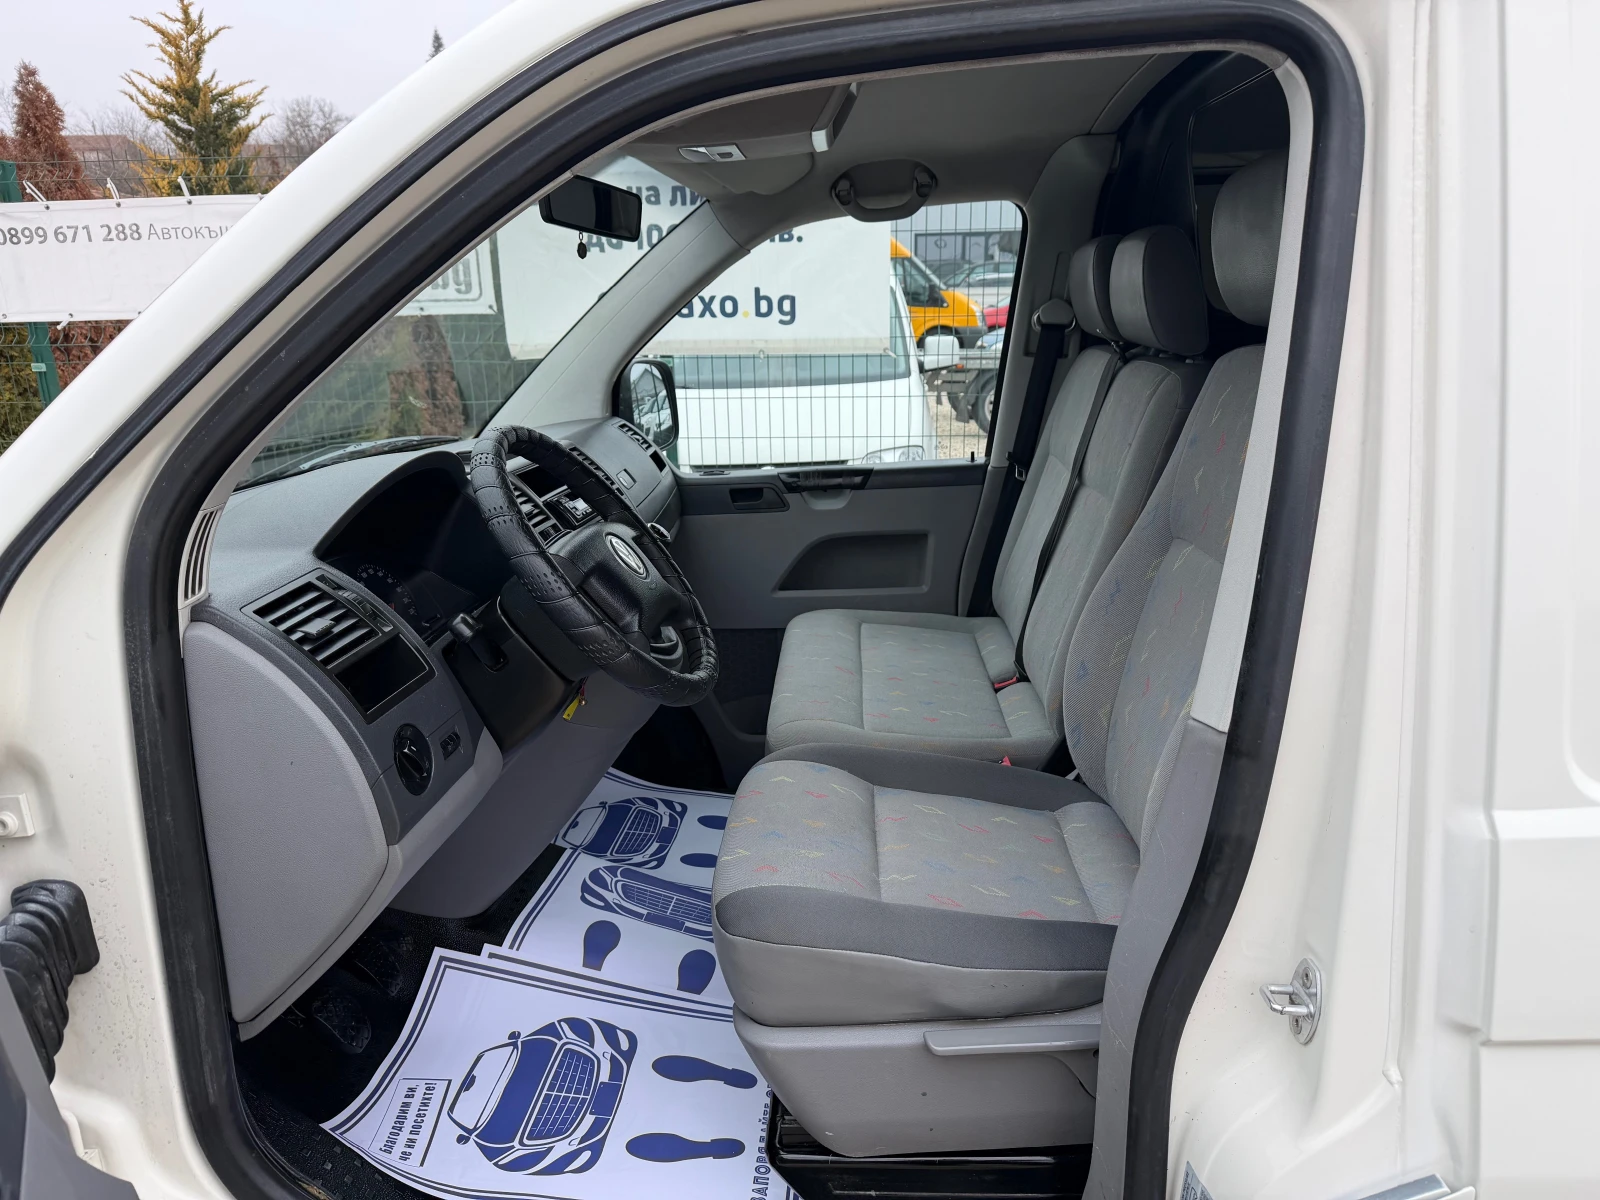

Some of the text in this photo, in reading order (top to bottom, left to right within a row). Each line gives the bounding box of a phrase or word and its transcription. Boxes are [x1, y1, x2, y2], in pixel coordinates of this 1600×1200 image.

[53, 224, 93, 244] 671
[100, 222, 143, 242] 288
[404, 1084, 420, 1100] ви,
[398, 1082, 437, 1162] че ни посетихте!
